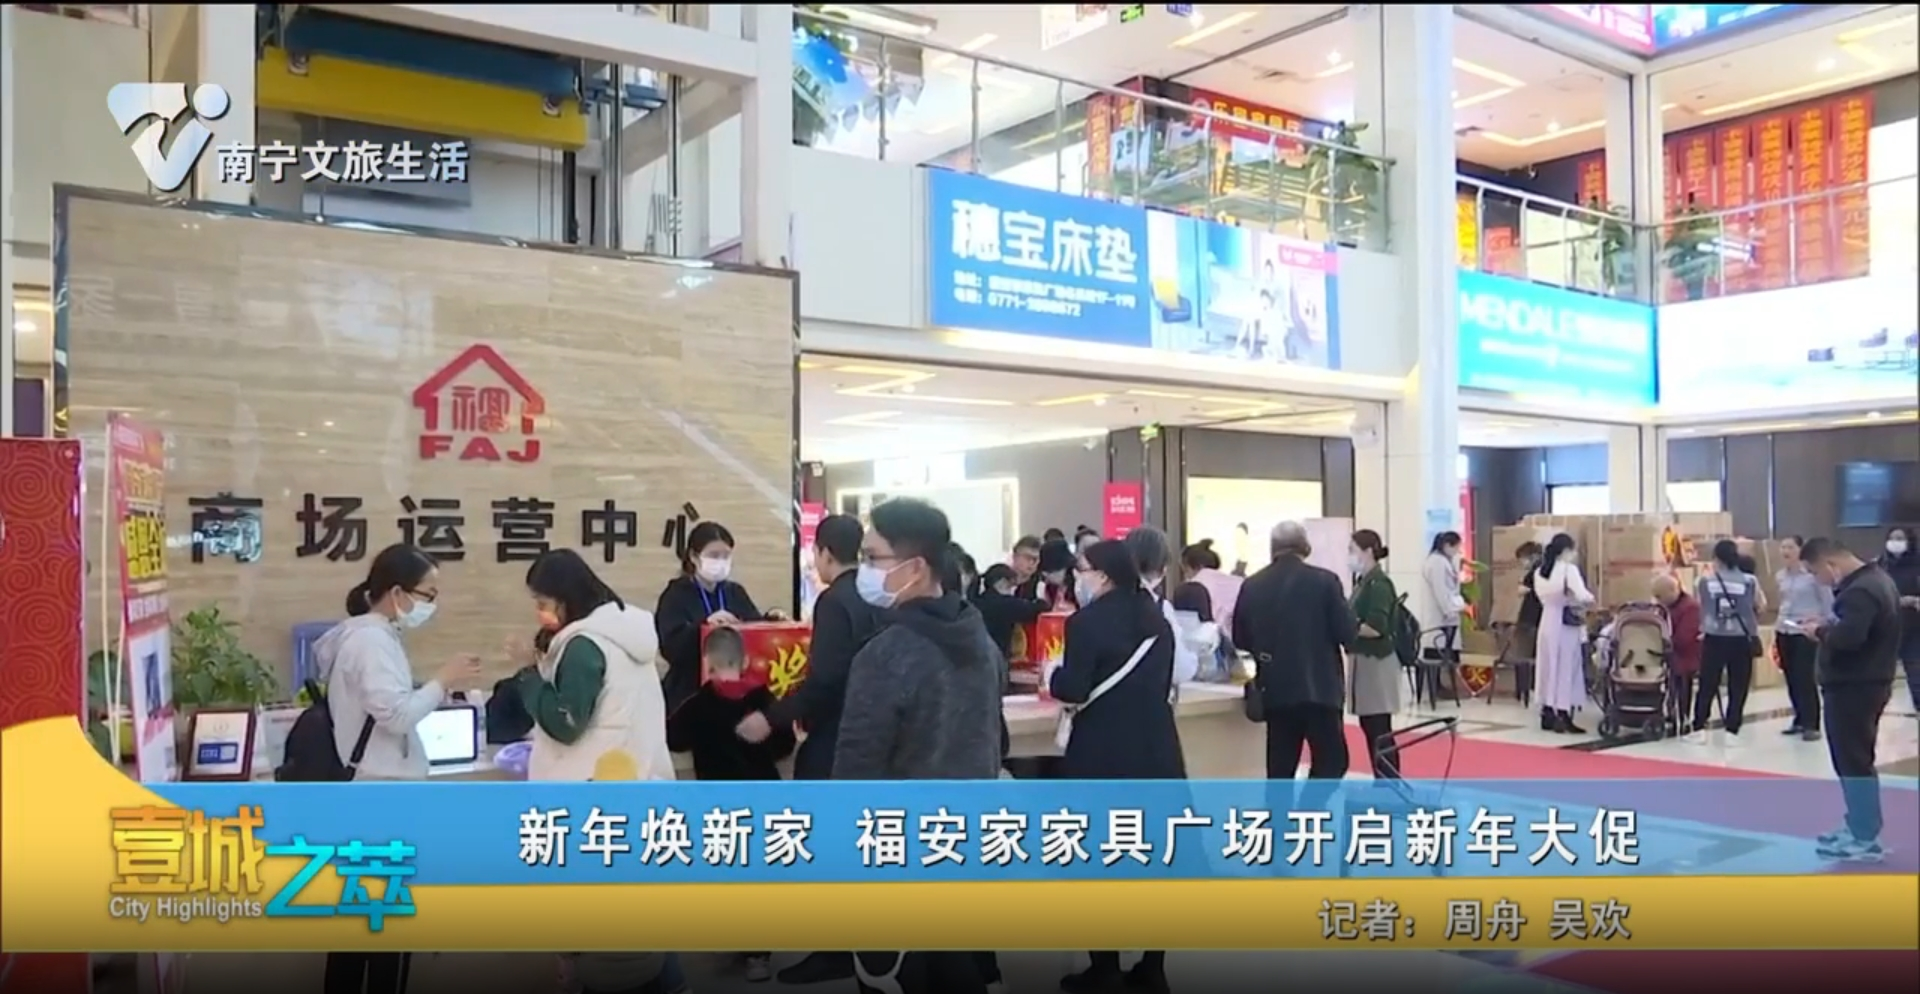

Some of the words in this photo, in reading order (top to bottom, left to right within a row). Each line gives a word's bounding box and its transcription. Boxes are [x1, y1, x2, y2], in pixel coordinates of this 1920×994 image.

[951, 198, 1138, 284] 穗宝床垫
[419, 434, 541, 463] FAJ
